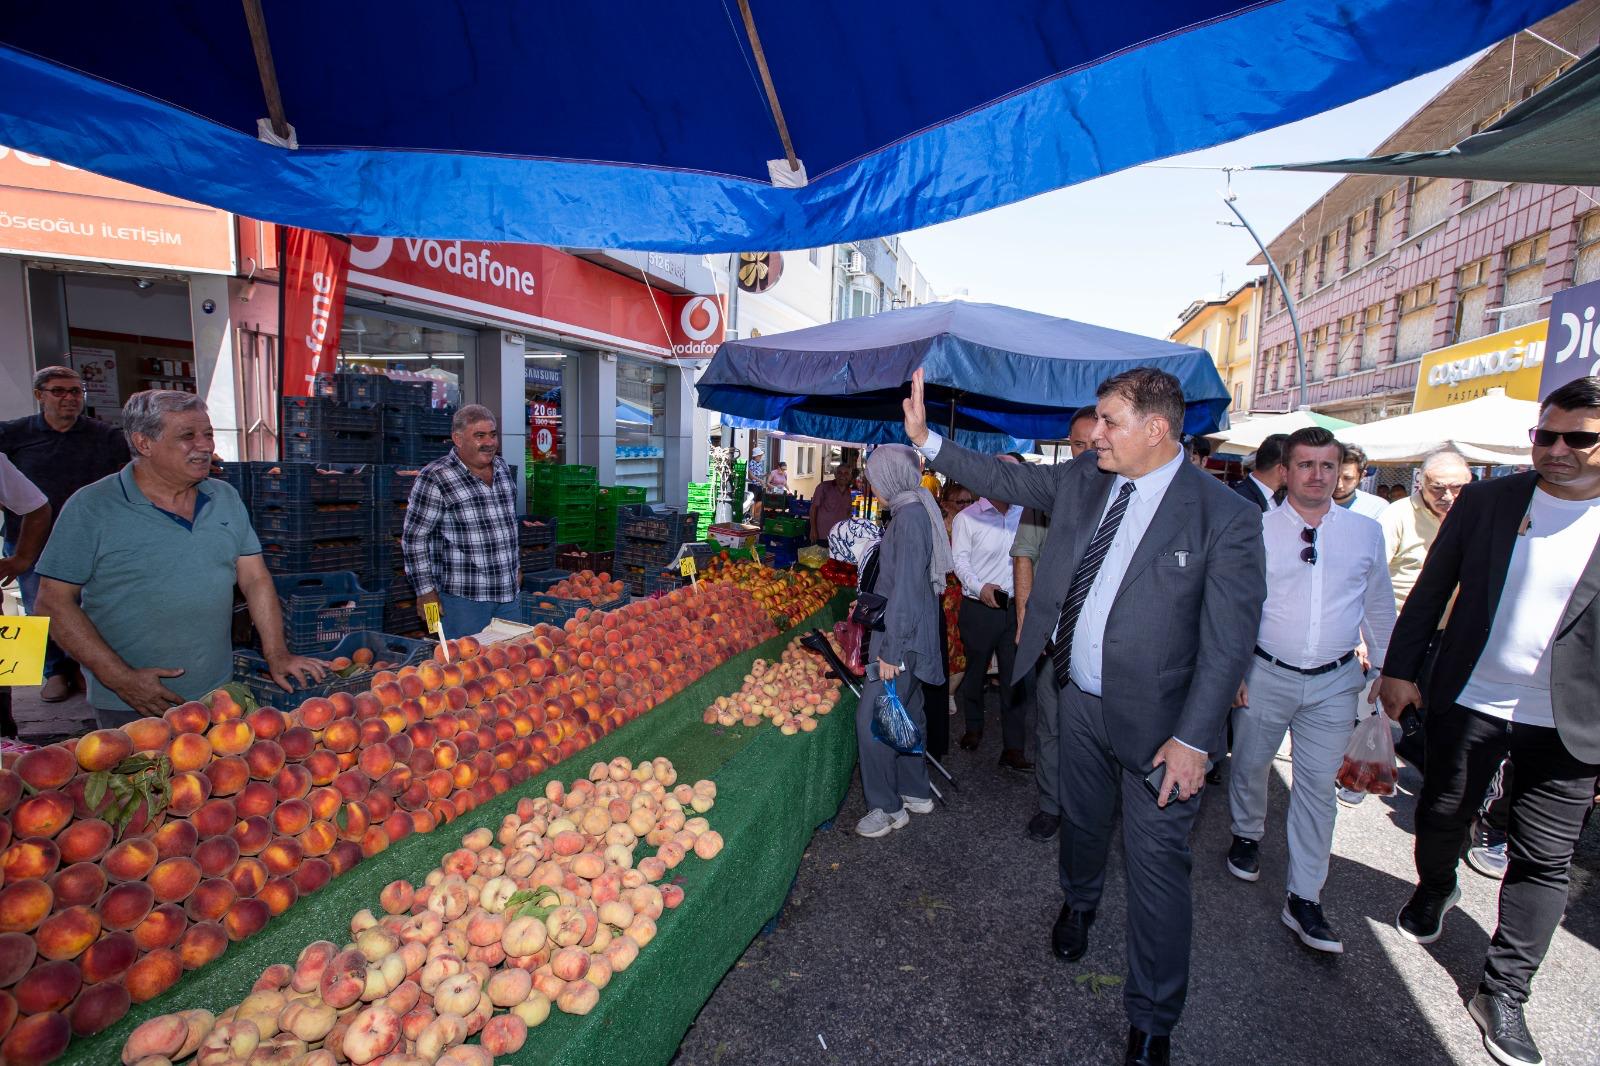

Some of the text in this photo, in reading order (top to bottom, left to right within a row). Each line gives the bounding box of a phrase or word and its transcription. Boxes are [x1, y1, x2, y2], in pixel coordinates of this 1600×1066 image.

[102, 223, 182, 246] İLETİŞİM
[404, 238, 535, 296] vodafone
[534, 404, 545, 416] 20
